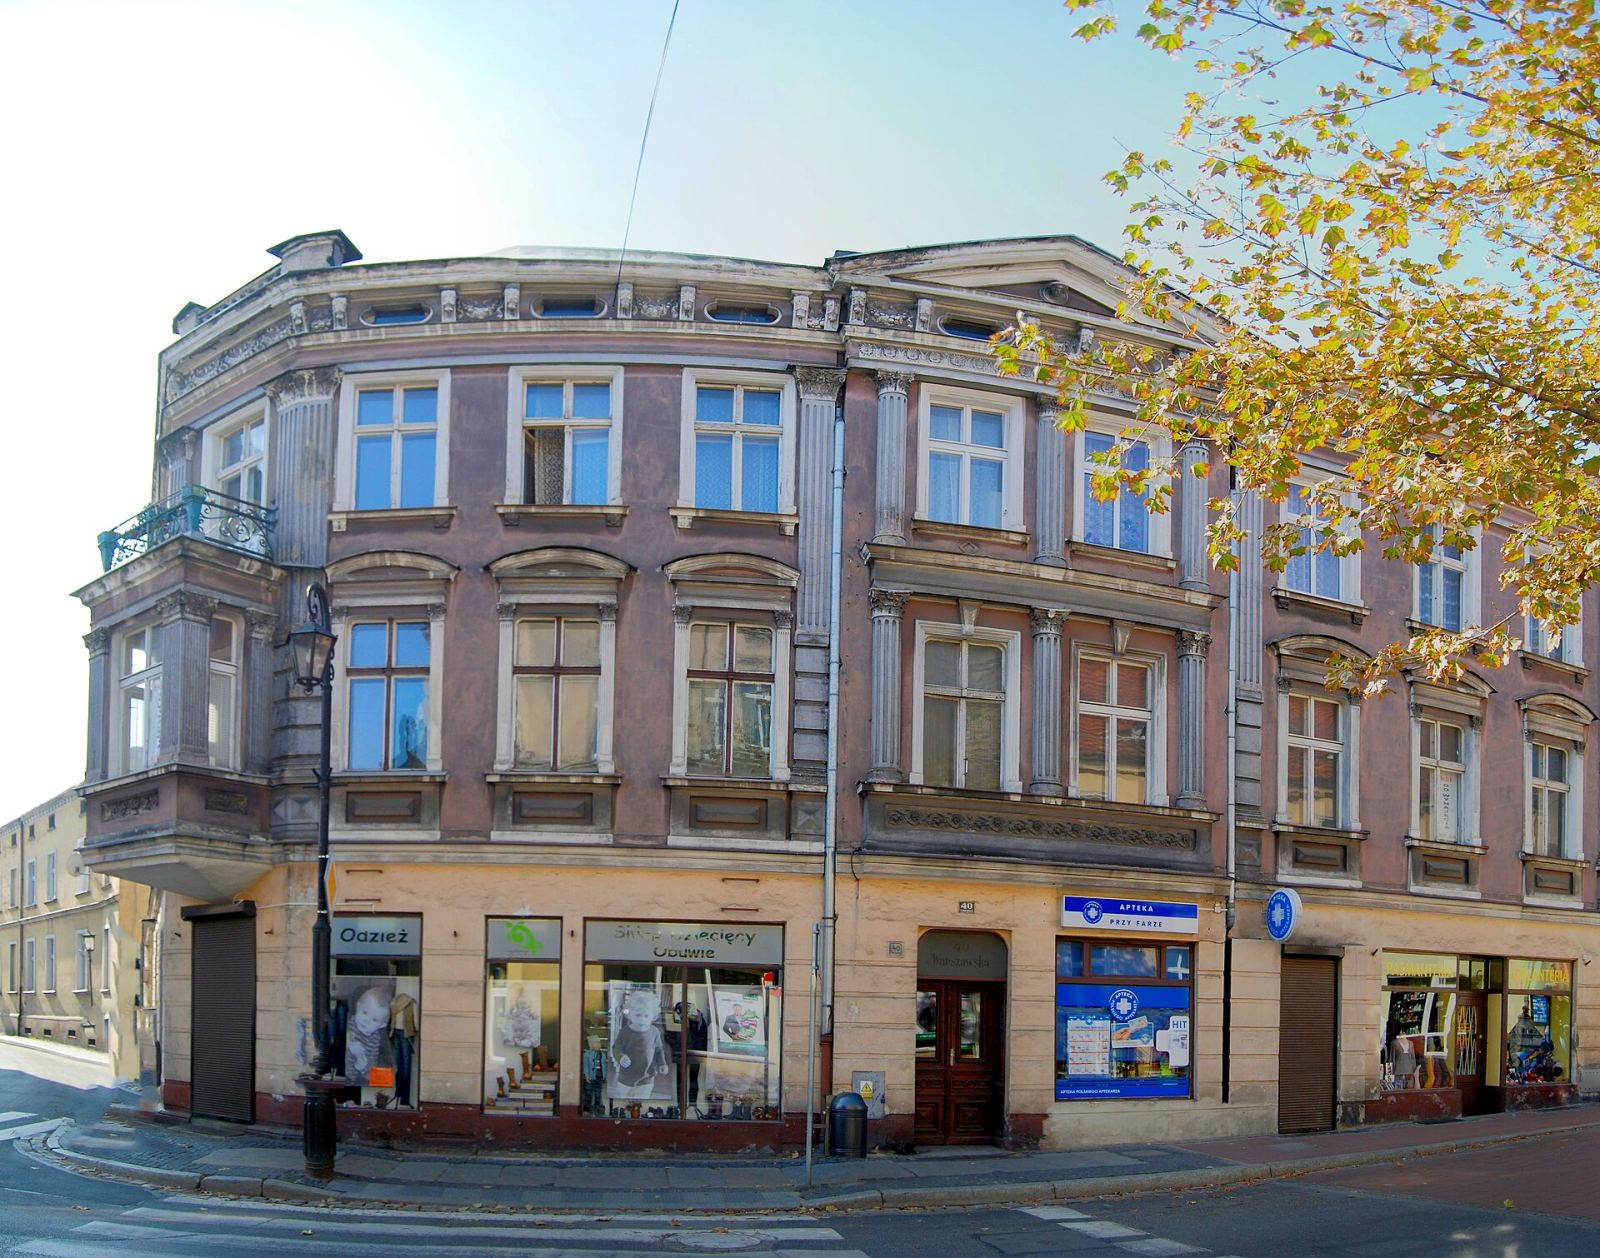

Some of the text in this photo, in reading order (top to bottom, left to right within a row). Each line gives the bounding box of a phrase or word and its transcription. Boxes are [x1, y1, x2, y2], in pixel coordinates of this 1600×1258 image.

[960, 902, 973, 910] 40
[1119, 903, 1154, 913] APTEKA
[1109, 919, 1163, 928] PRZY FARZE
[1172, 1020, 1187, 1029] HIT
